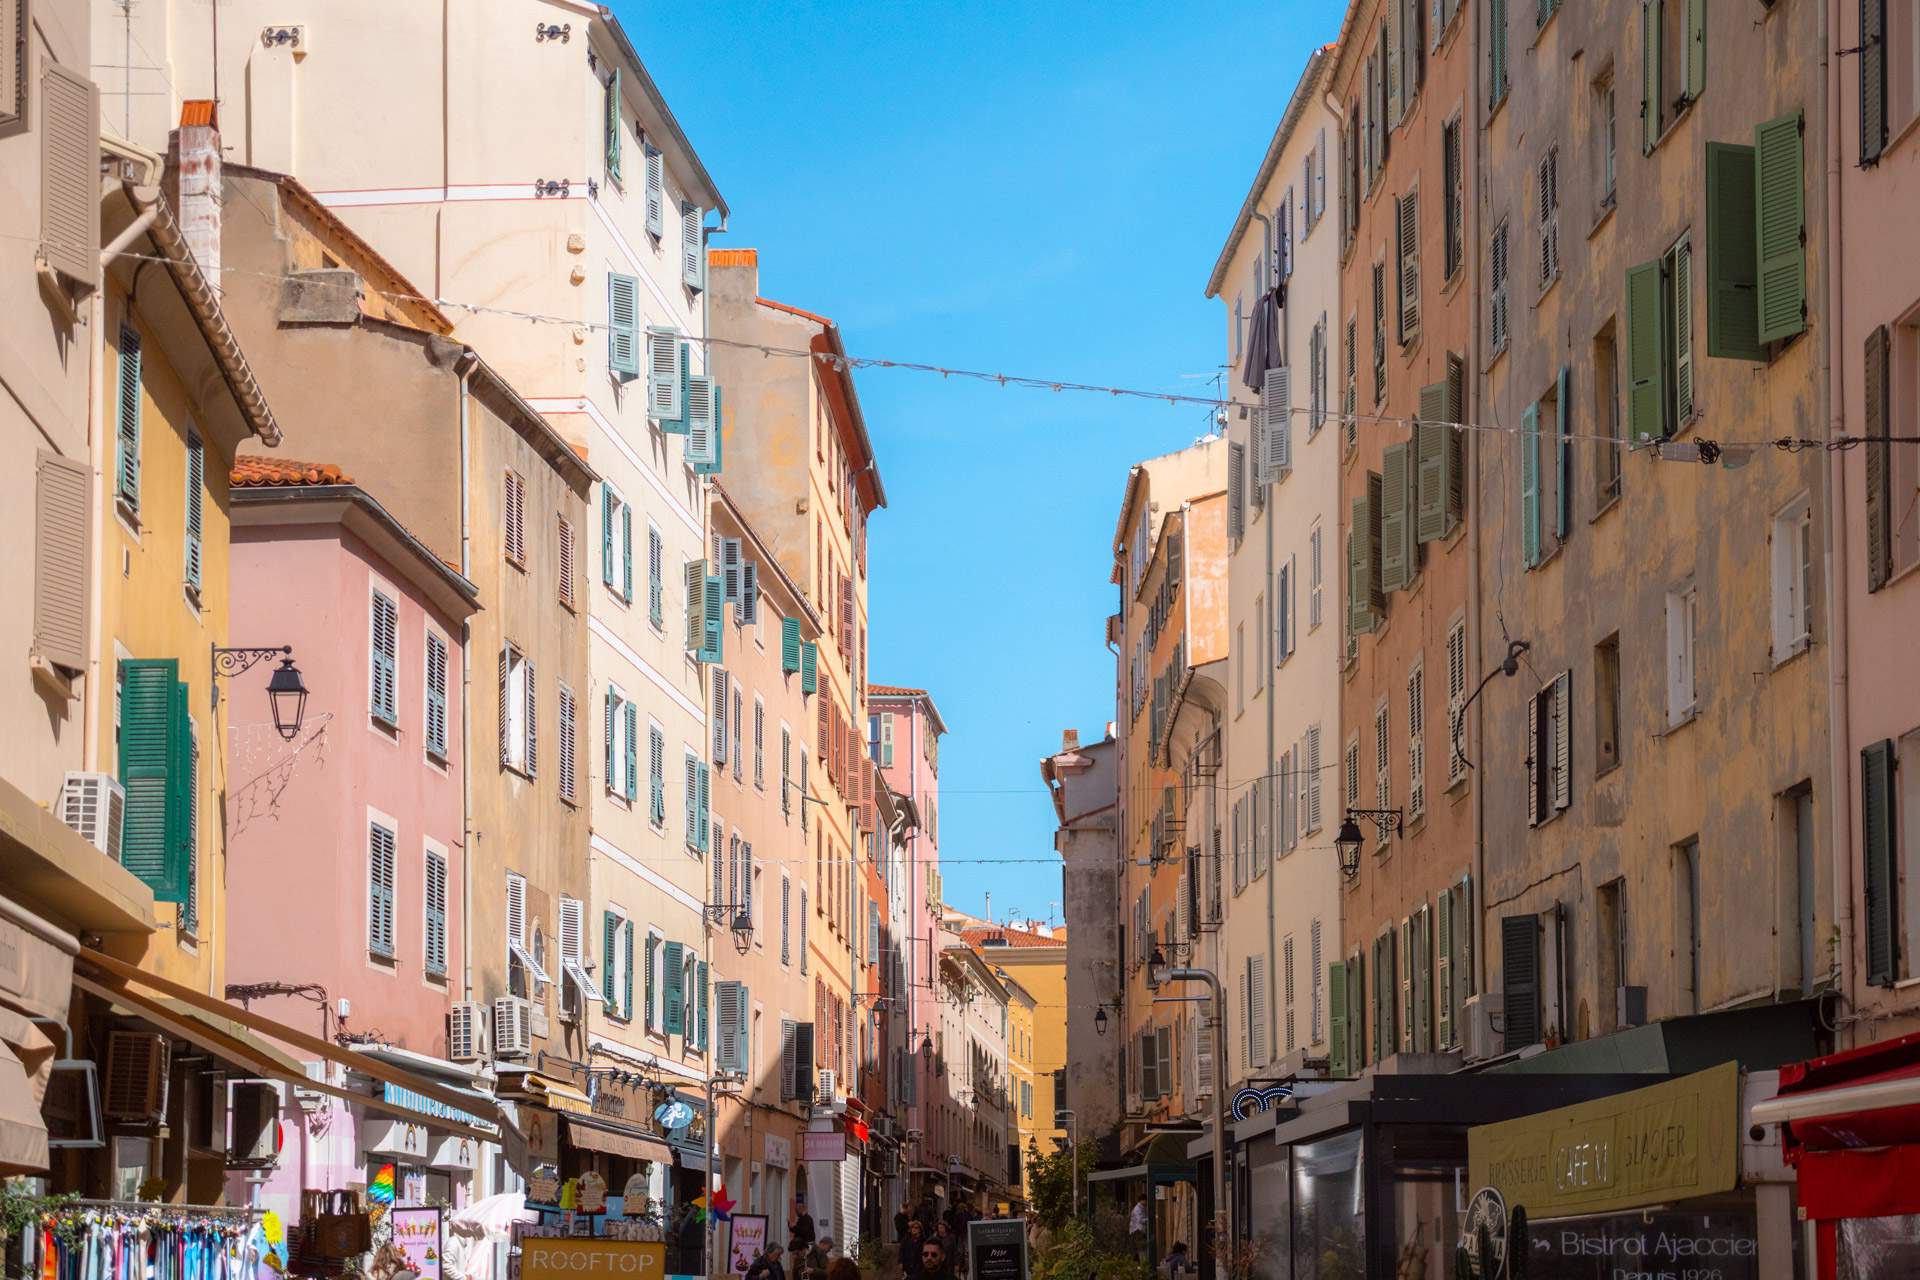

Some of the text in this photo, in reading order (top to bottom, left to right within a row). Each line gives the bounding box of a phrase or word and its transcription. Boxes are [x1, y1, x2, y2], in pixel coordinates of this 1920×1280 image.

[1489, 1154, 1547, 1186] BRASSERIE
[1561, 1231, 1648, 1255] Bistrot
[532, 1250, 654, 1272] ROOFTOP
[1613, 1268, 1676, 1280] Depuis
